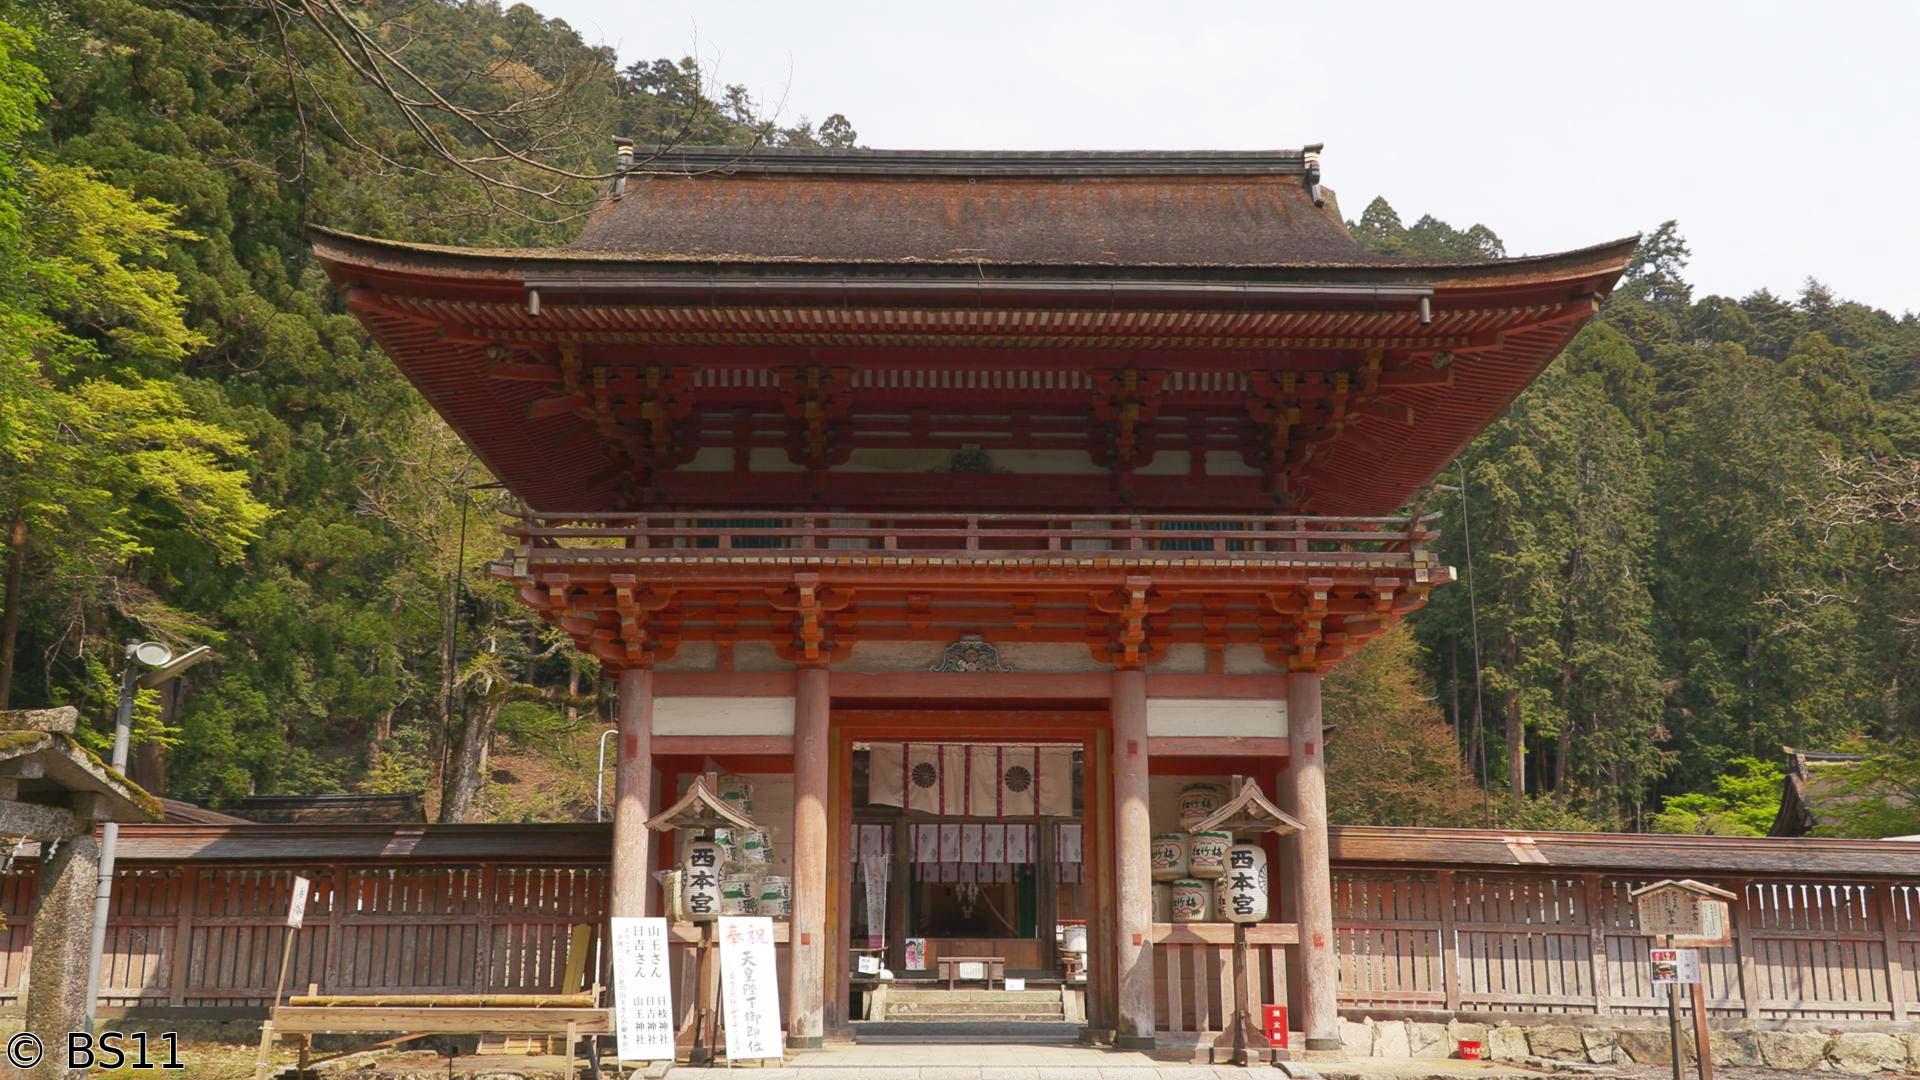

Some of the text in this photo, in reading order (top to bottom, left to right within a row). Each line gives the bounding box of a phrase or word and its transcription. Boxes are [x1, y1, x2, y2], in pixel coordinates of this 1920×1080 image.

[1192, 846, 1223, 858] 松竹梅
[690, 848, 716, 914] 西本宮
[1231, 850, 1256, 915] 西本宮
[633, 925, 647, 978] 日吉さん
[648, 925, 662, 978] 山王さん
[726, 923, 769, 946] 奉祝
[633, 996, 646, 1045] 山王神社
[646, 996, 657, 1045] 日吉神社
[657, 996, 670, 1045] 日枝神社
[742, 950, 765, 1053] 天皇陛下御即位
